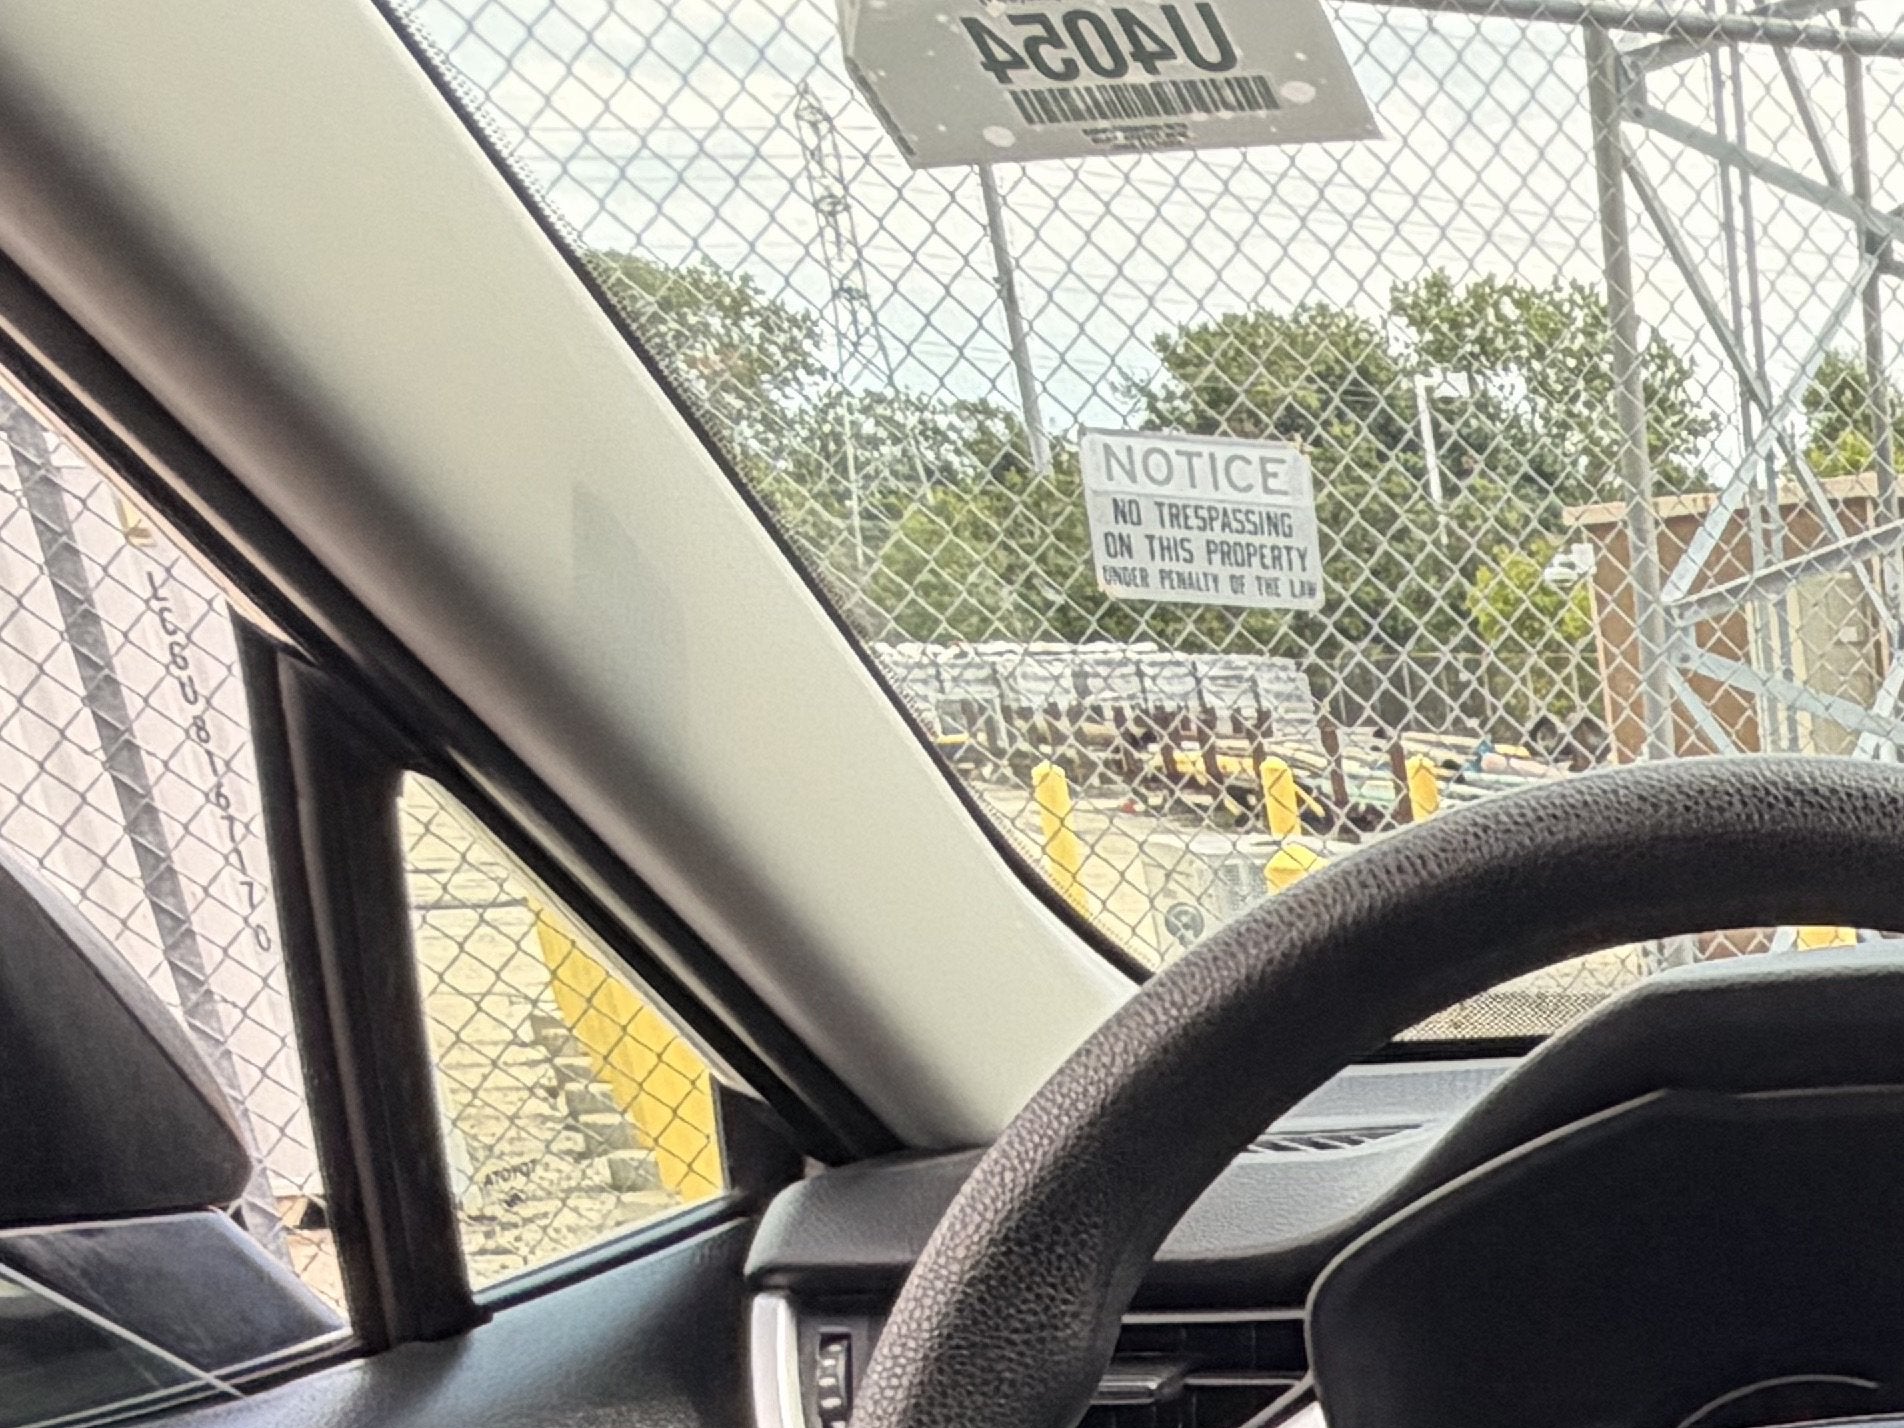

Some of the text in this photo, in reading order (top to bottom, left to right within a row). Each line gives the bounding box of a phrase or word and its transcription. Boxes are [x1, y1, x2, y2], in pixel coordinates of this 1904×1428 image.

[1102, 442, 1289, 496] NOTICE
[1112, 498, 1293, 538] NO TRESPASSING
[1104, 532, 1308, 572] ON THIS PROPERTY
[1158, 568, 1220, 593] PENALTY
[1229, 574, 1246, 597] OF
[1255, 575, 1282, 598] THE
